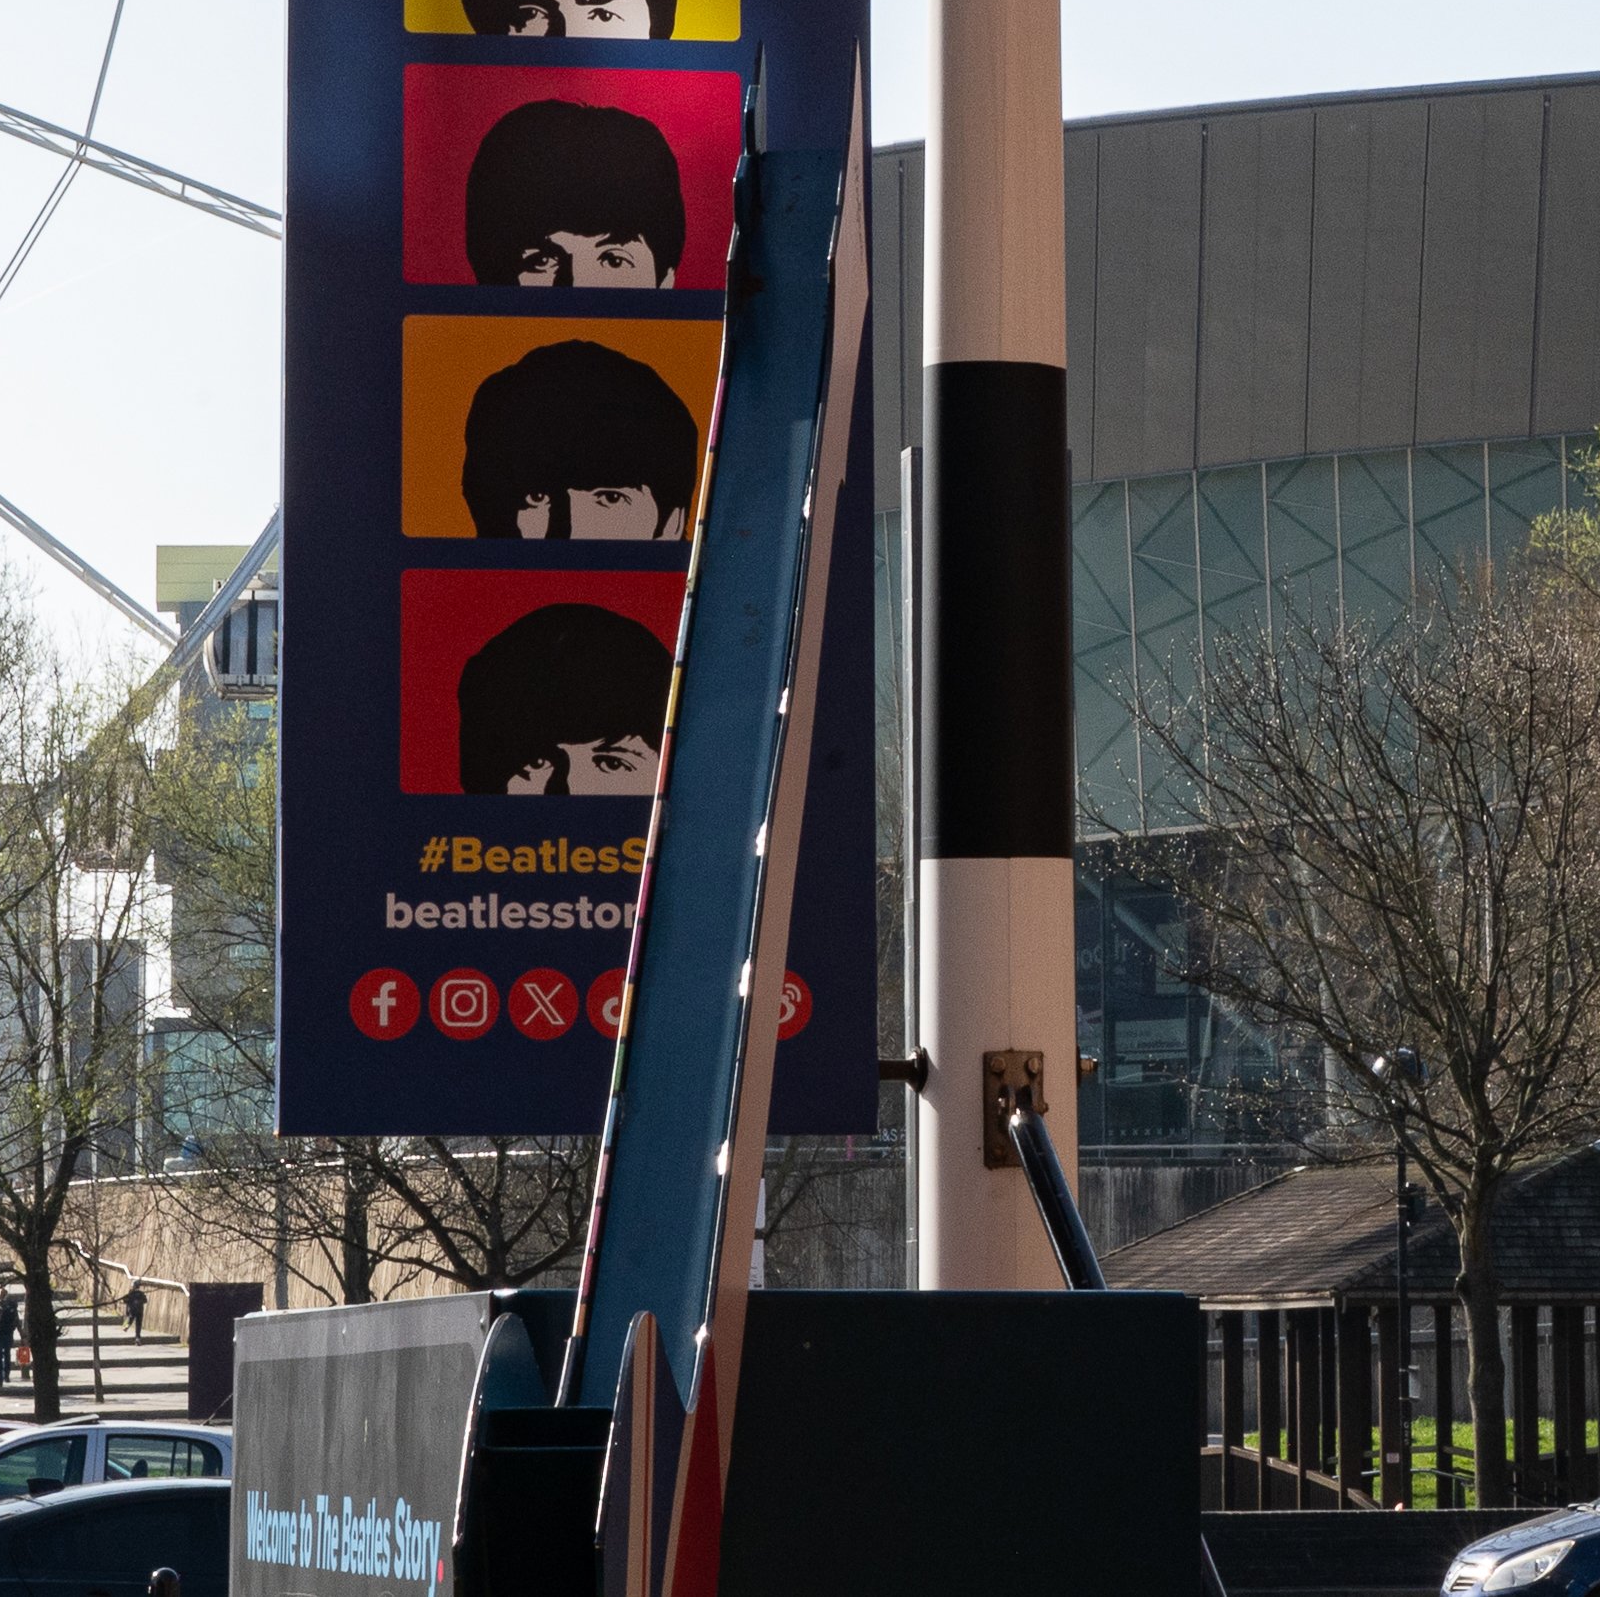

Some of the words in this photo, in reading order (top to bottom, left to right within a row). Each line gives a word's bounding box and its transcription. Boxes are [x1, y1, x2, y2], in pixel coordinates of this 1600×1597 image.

[247, 1490, 297, 1567] Welcome
[300, 1499, 313, 1568] to
[316, 1494, 339, 1572] The
[341, 1495, 391, 1578] Beatles
[394, 1497, 444, 1597] Story.
